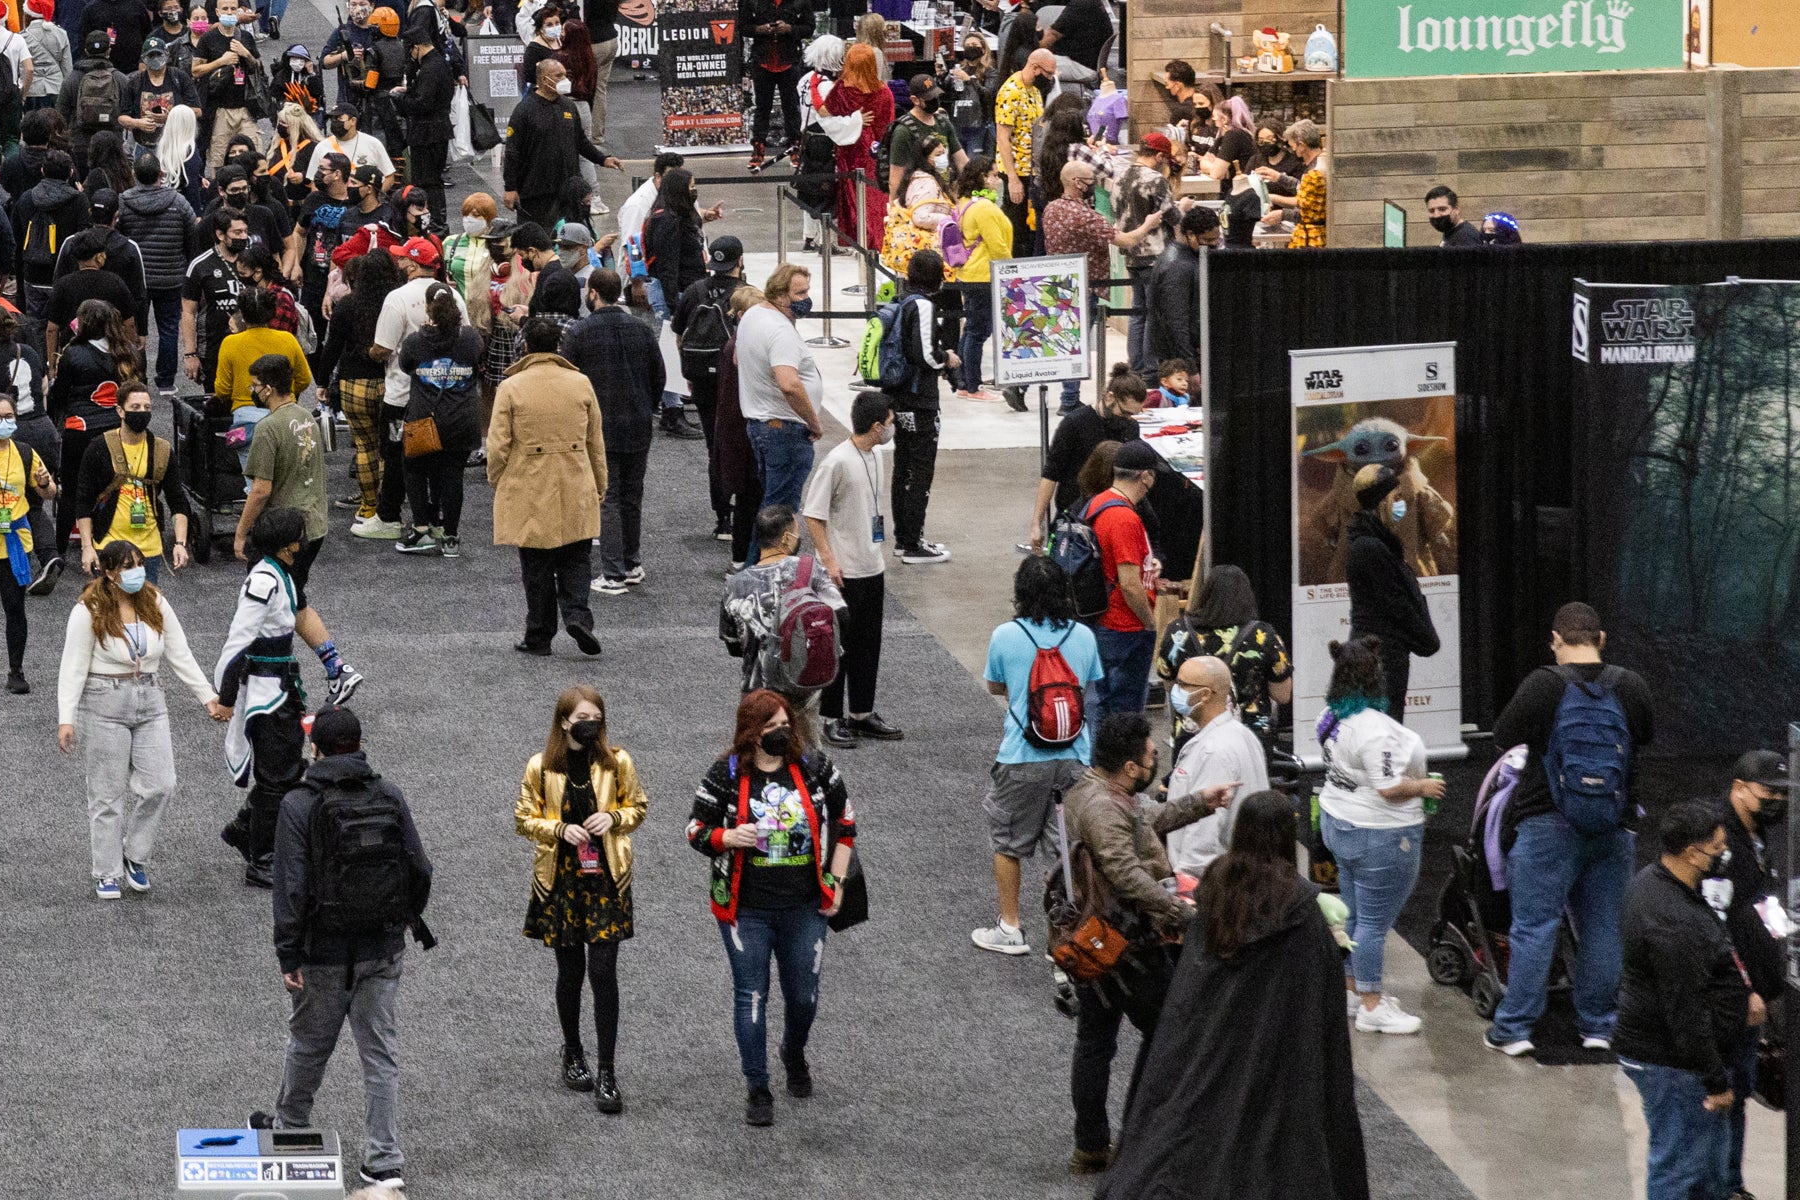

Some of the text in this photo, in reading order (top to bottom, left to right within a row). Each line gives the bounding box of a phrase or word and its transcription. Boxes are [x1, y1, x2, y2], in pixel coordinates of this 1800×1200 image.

[662, 29, 709, 42] LEGION
[480, 45, 507, 56] REDEEM
[473, 55, 491, 65] FREE
[491, 54, 513, 64] SHARE
[676, 60, 727, 71] FAN-OWNED
[677, 69, 727, 78] MEDIA COMPANY
[670, 119, 684, 127] JOIN
[1601, 298, 1694, 321] STAR
[1601, 319, 1694, 342] WARS
[1600, 345, 1695, 364] MANDALORIAN
[1012, 369, 1058, 381] Liquid Avatar
[1304, 369, 1343, 381] STAR
[1305, 378, 1343, 390] WARS
[1417, 382, 1446, 392] SIDESHOW
